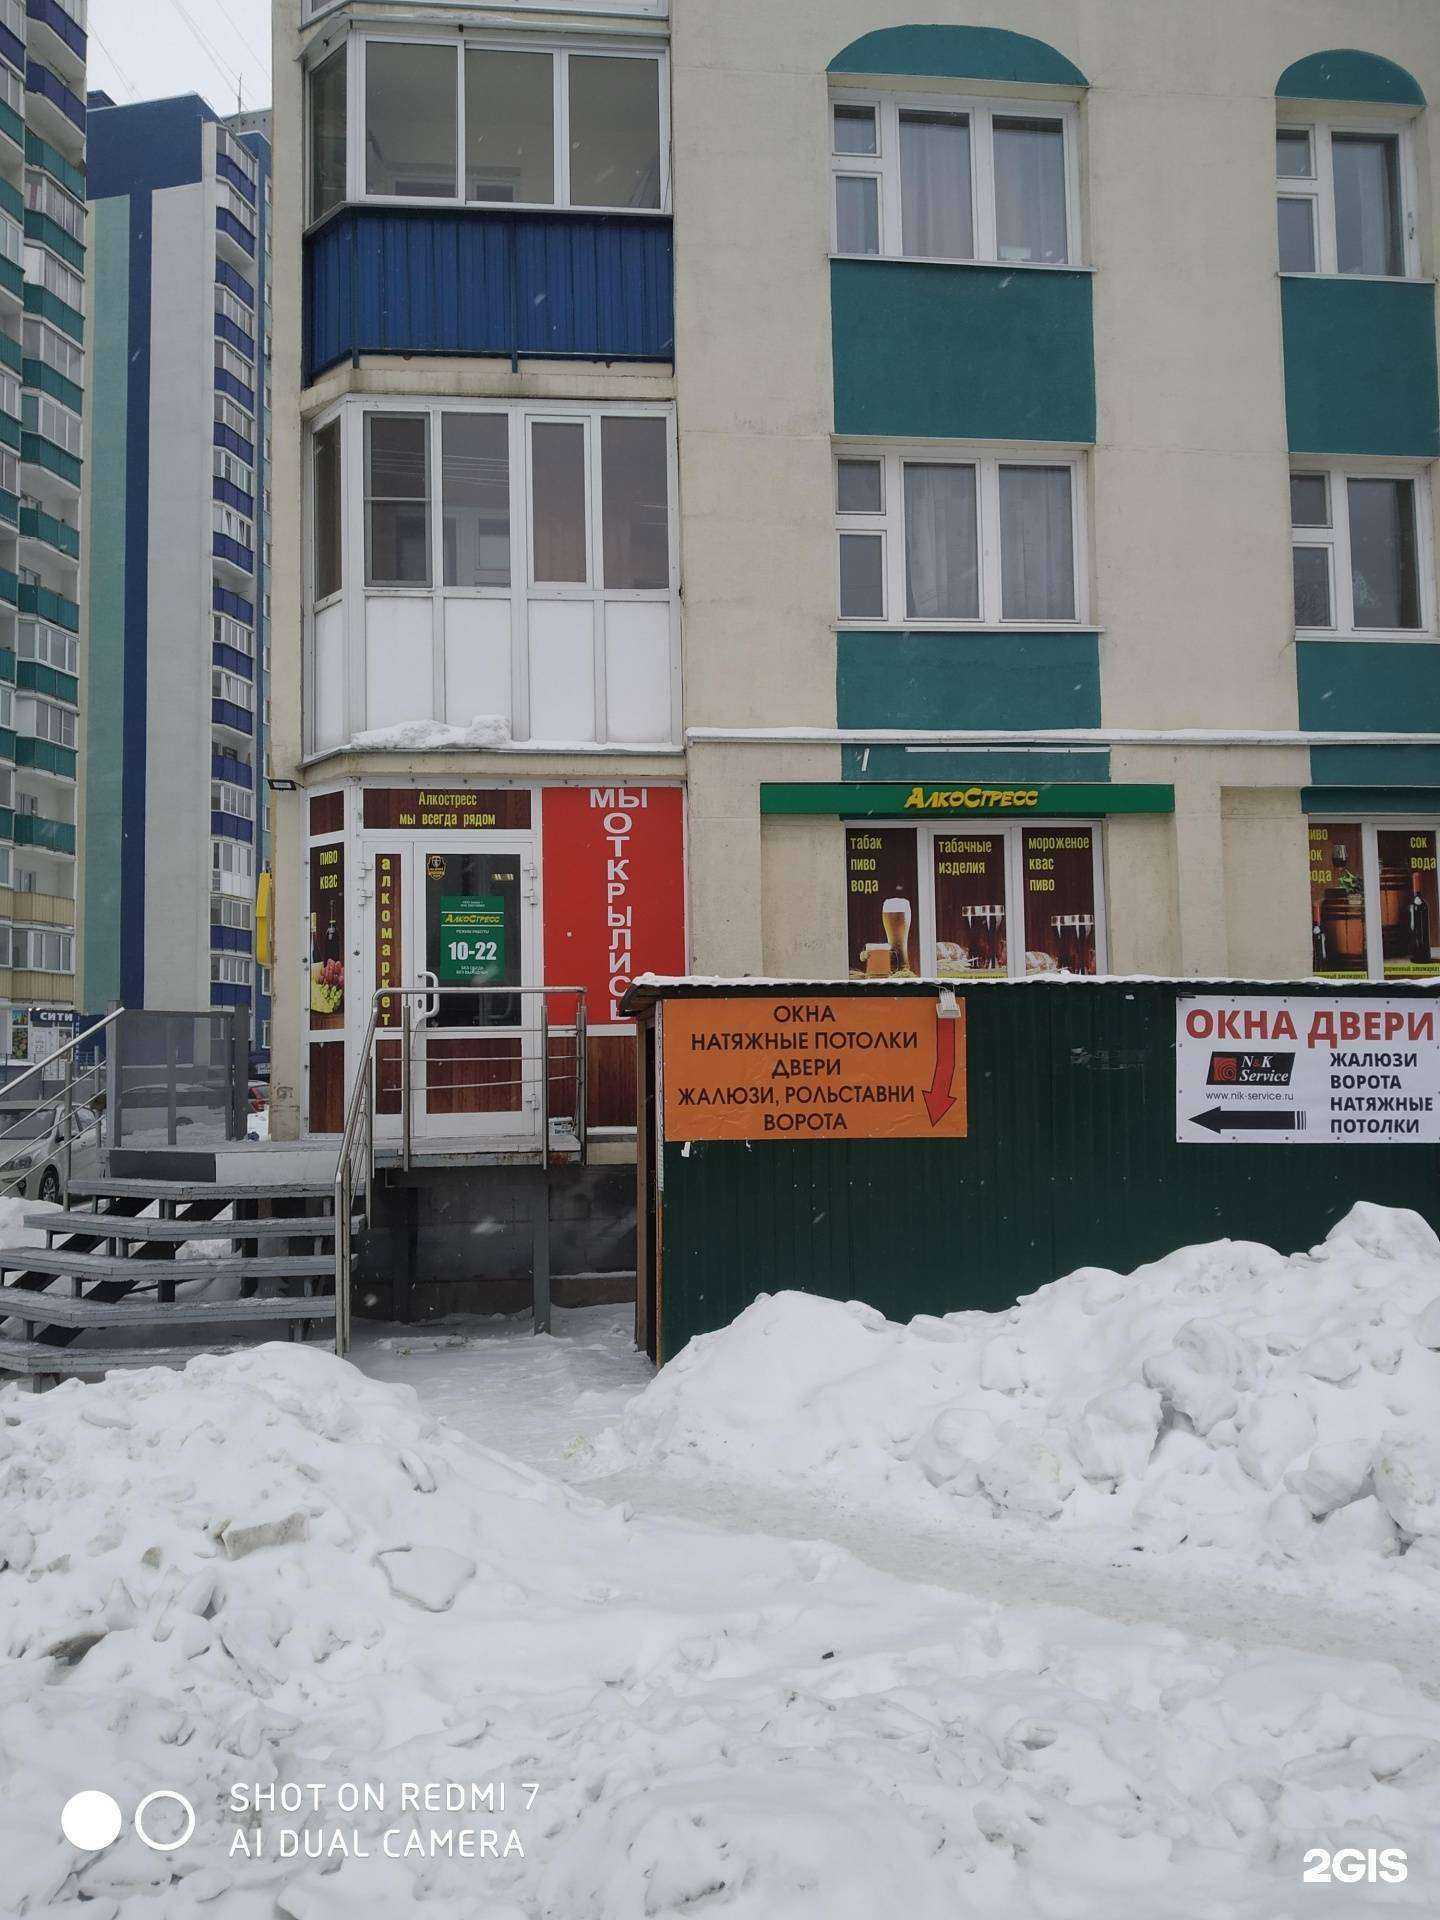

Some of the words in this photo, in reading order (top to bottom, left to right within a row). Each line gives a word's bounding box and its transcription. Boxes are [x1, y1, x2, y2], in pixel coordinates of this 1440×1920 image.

[418, 791, 477, 808] Алкостресс
[589, 788, 648, 808] МЫ
[399, 814, 415, 824] мы
[422, 813, 457, 826] всегда
[463, 814, 496, 827] рядом
[850, 835, 882, 850] табак
[938, 838, 992, 854] табачные
[1028, 836, 1090, 851] мороженое
[1410, 836, 1428, 849] сок
[319, 850, 338, 866] пиво
[1308, 849, 1323, 861] ок
[850, 858, 876, 871] пиво
[938, 861, 986, 876] изделия
[1029, 857, 1054, 870] квас
[1411, 856, 1437, 870] вода
[319, 874, 338, 890] квас
[851, 879, 879, 894] вода
[1029, 878, 1055, 891] пиво
[448, 941, 498, 961] 10-22
[40, 1012, 73, 1022] СИТИ
[773, 1005, 836, 1022] ОКНА
[1185, 1009, 1298, 1040] ОКНА
[1307, 1011, 1434, 1049] ДВЕРИ
[691, 1032, 809, 1050] НАТЯЖНЫЕ
[815, 1031, 918, 1049] ПОТОЛКИ
[1330, 1052, 1418, 1067] ЖАЛЮЗИ
[771, 1058, 841, 1079] ДВЕРИ
[1239, 1069, 1289, 1082] Service
[1330, 1075, 1402, 1090] ВОРОТА
[678, 1087, 780, 1107] ЖАЛЮЗИ,
[785, 1085, 915, 1104] РОЛЬСТАВНИ
[1205, 1090, 1294, 1101] www.nik-service.ru
[1330, 1097, 1434, 1112] НАТЯЖНЫЕ
[764, 1113, 848, 1131] ВОРОТА
[1330, 1119, 1420, 1134] ПОТОЛКИ
